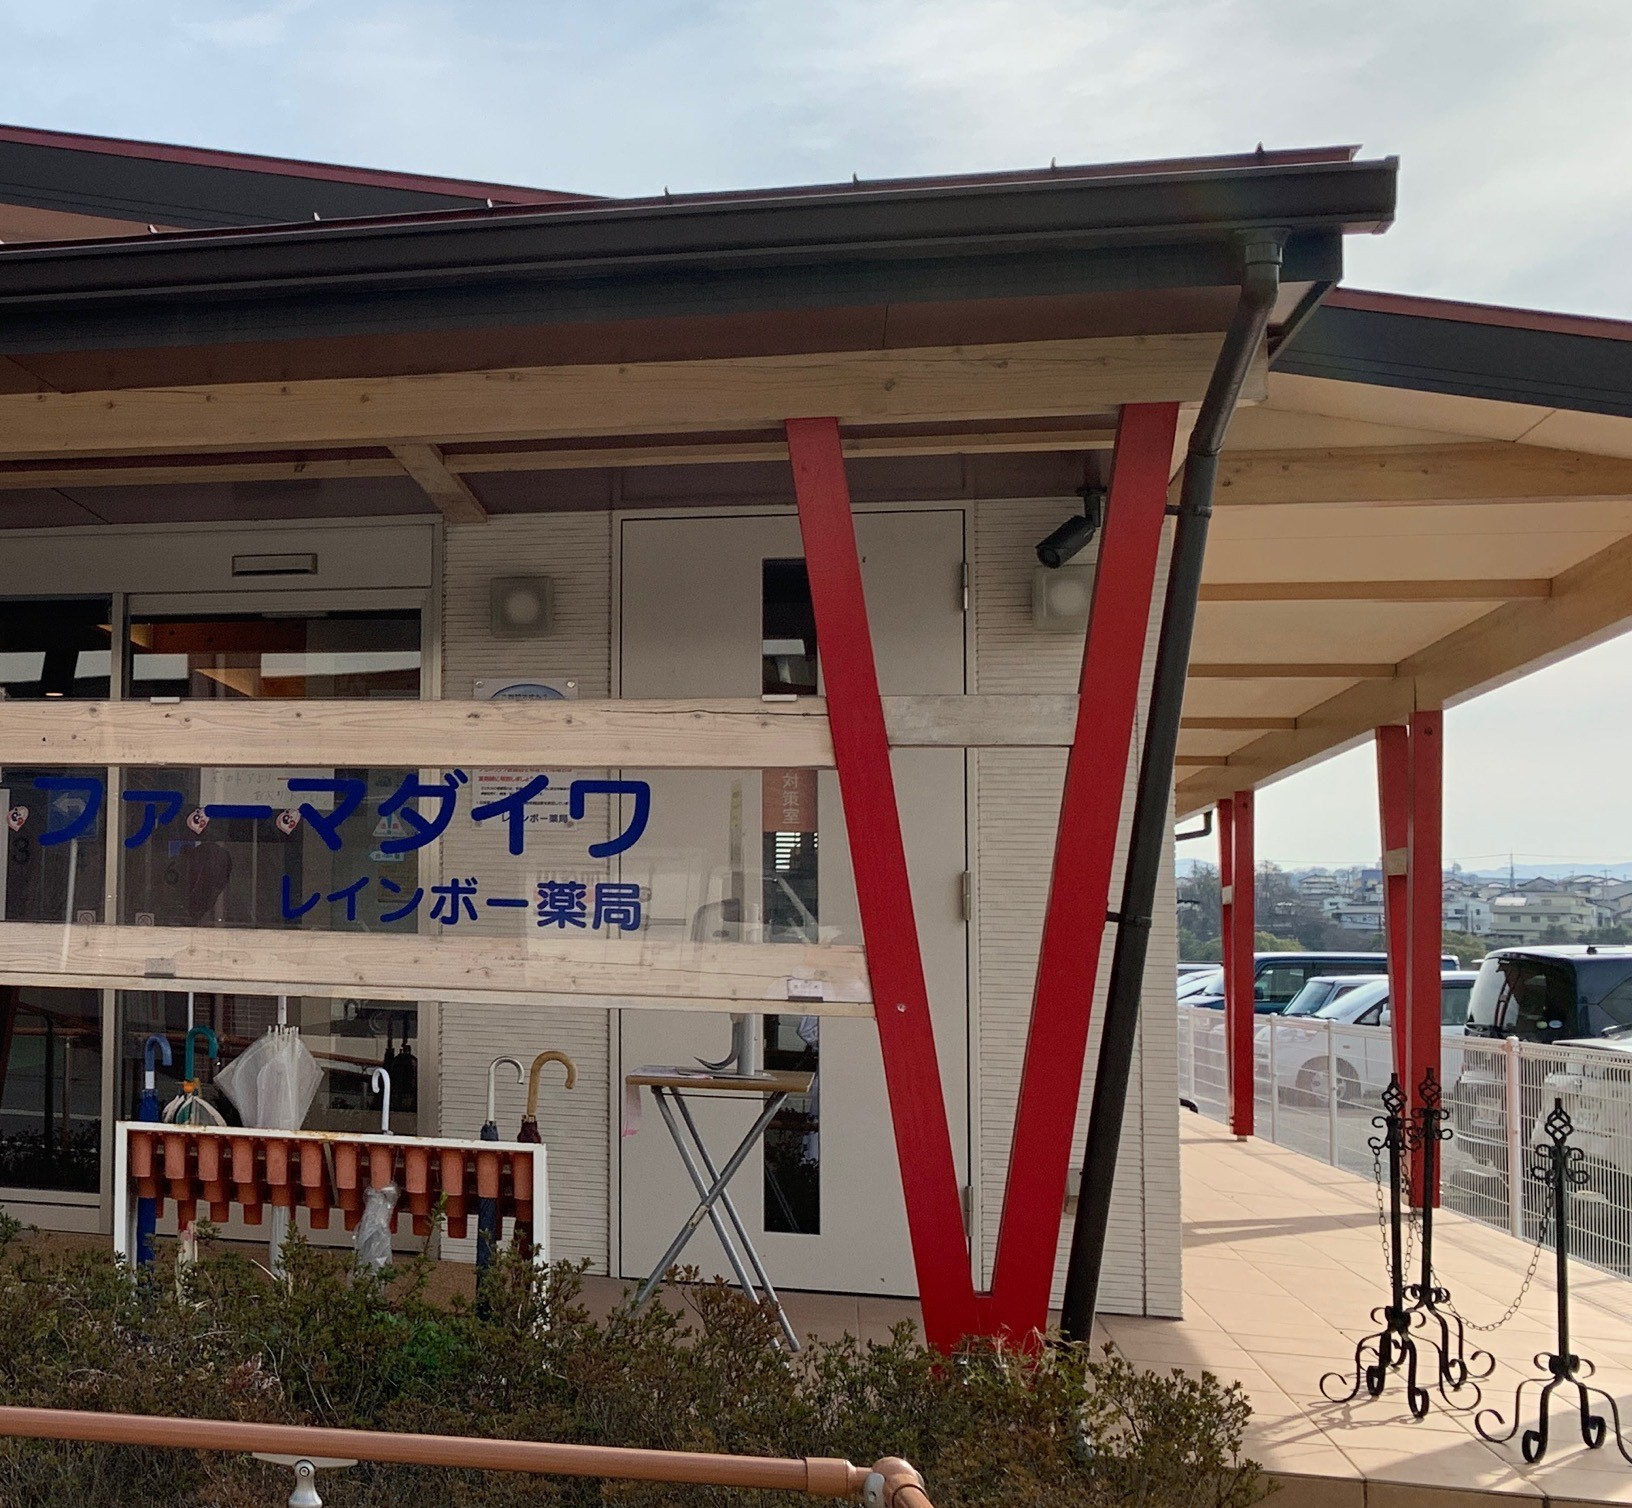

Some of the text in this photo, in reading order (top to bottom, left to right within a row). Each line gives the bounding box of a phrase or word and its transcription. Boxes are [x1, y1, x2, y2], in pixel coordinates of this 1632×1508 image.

[34, 772, 651, 859] ファーマダイワ
[502, 813, 569, 824] レンボー薬局
[282, 877, 641, 931] レインボー薬局
